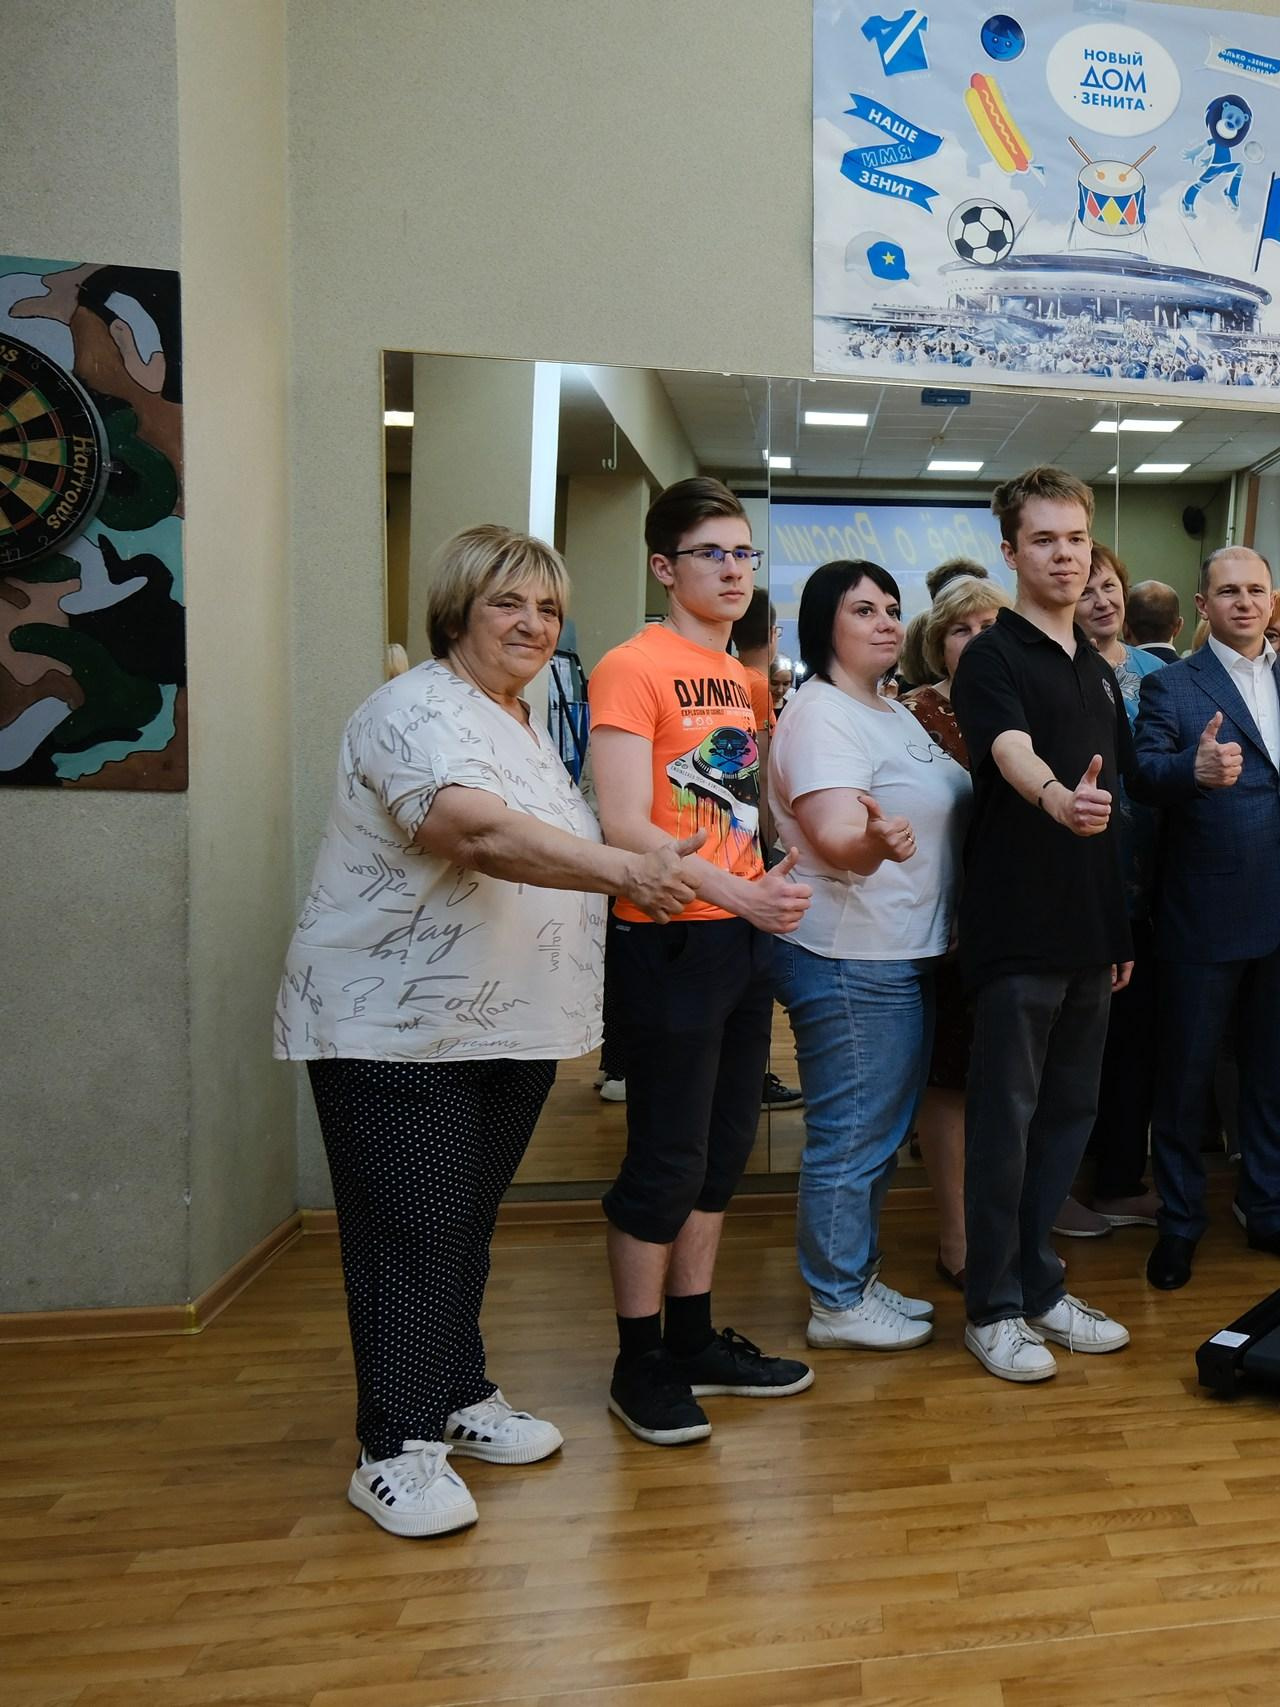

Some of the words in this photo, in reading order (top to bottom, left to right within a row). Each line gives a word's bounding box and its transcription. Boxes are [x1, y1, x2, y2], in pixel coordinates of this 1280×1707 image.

[1083, 48, 1143, 66] НОВЫЙ
[1219, 49, 1246, 61] ОЛЬКО
[1080, 65, 1147, 93] ДОМ
[1081, 91, 1145, 111] ЗЕНИТА
[867, 108, 919, 143] НАШЕ
[861, 144, 912, 168] ИМЯ
[859, 170, 914, 198] ЗЕНИТ
[46, 434, 95, 529] Harrows
